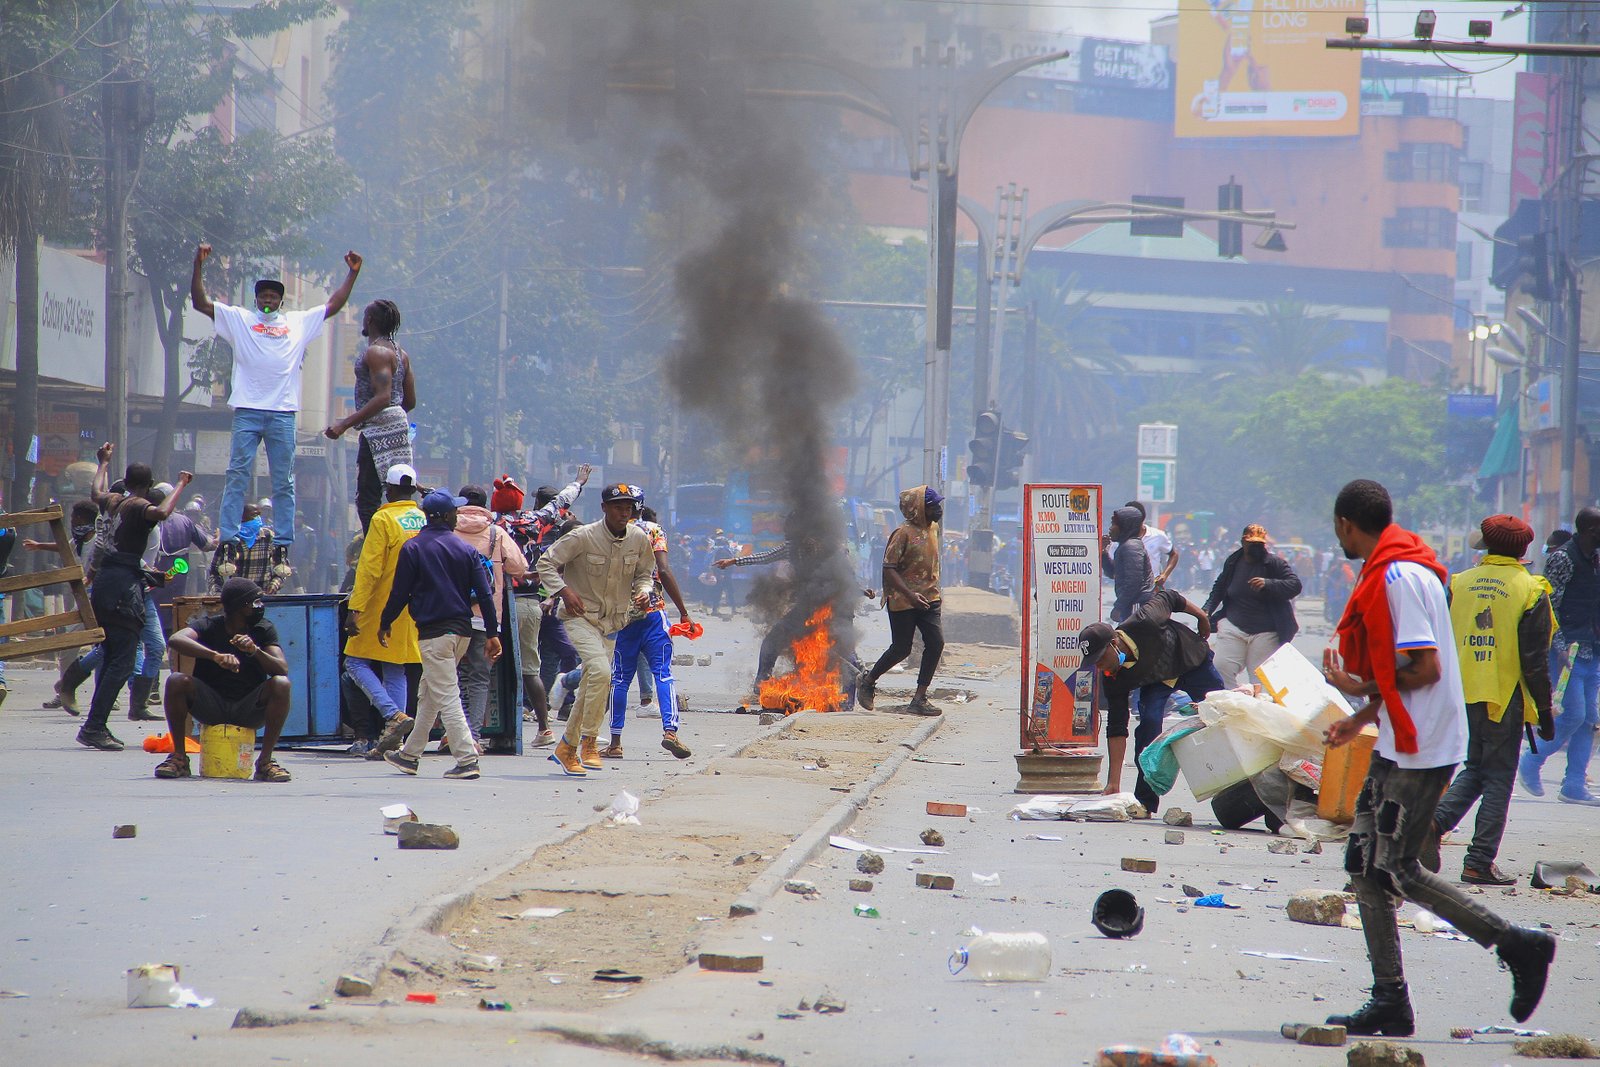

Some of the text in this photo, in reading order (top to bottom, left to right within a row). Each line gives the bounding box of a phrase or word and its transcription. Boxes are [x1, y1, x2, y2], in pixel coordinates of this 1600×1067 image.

[1263, 12, 1307, 28] LONG
[1094, 45, 1120, 61] GET
[1093, 61, 1137, 80] SHAPE
[42, 290, 65, 341] Galaxy
[75, 298, 94, 339] Series
[301, 446, 324, 455] STREET
[1042, 494, 1069, 509] ROUTE
[401, 517, 427, 529] SOK
[1035, 523, 1060, 533] SACCO
[1085, 524, 1096, 533] LTD
[1049, 546, 1086, 555] New Route Alert
[1044, 562, 1092, 575] WESTLANDS
[1051, 581, 1087, 593] KANGEMI
[1055, 599, 1083, 612] UTHIRU
[1057, 618, 1080, 631] KINOO
[1053, 656, 1080, 669] KIKUYU
